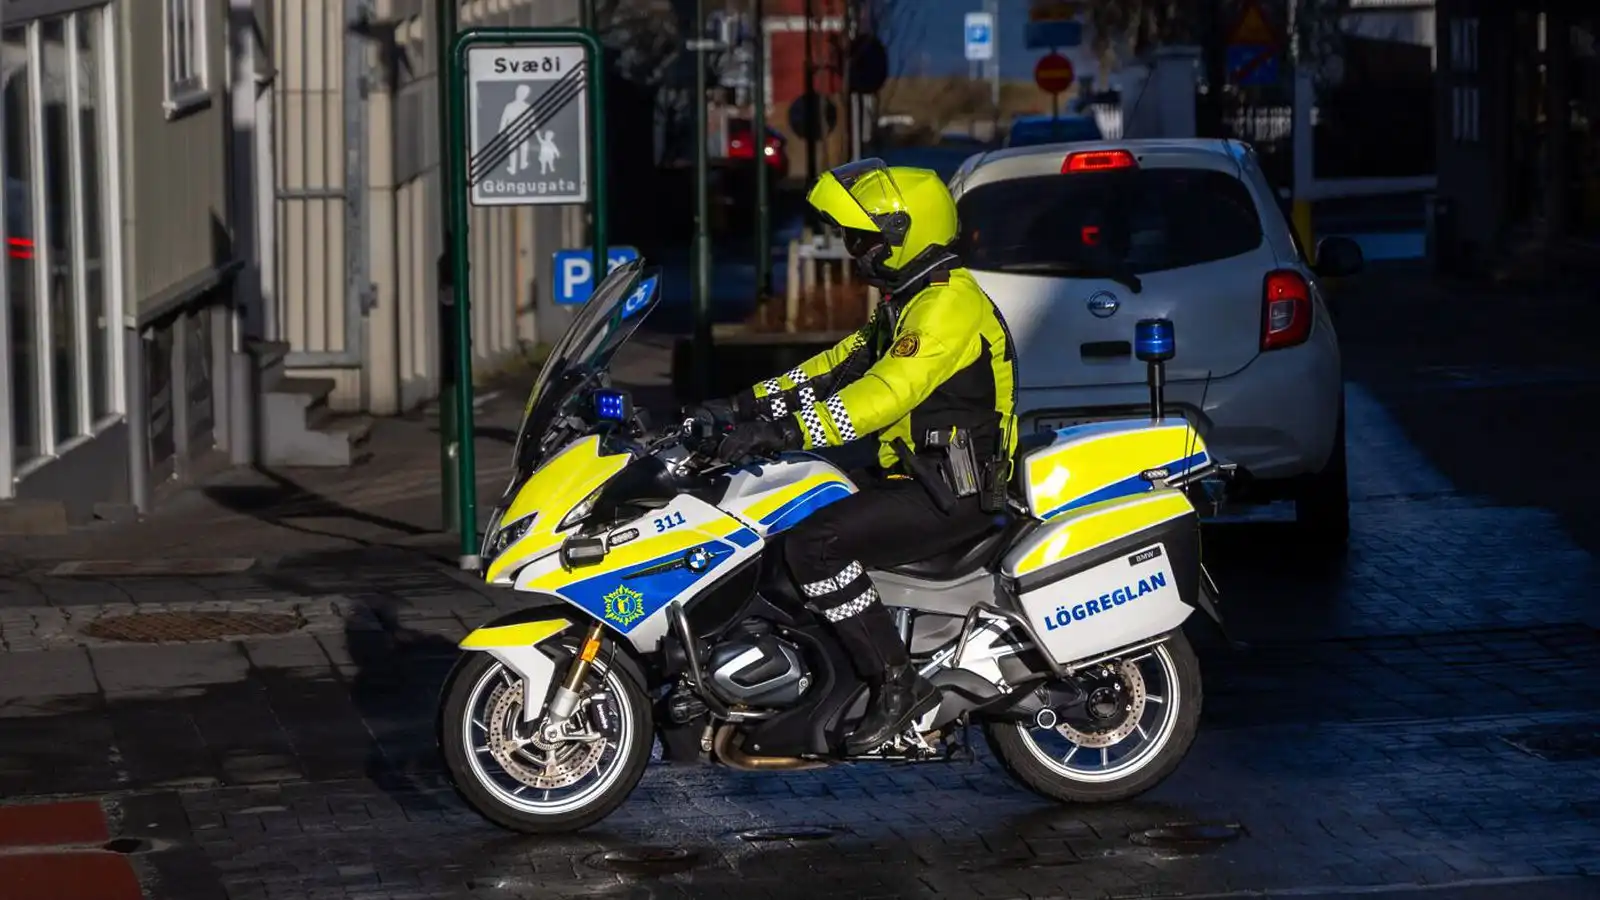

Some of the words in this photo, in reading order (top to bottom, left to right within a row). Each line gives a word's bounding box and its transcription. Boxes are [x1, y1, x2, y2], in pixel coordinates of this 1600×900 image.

[494, 57, 560, 73] Svæði
[482, 179, 576, 195] Göngugata
[563, 258, 592, 298] P
[654, 511, 686, 533] 311
[1044, 572, 1167, 631] LÖGREGLAN
